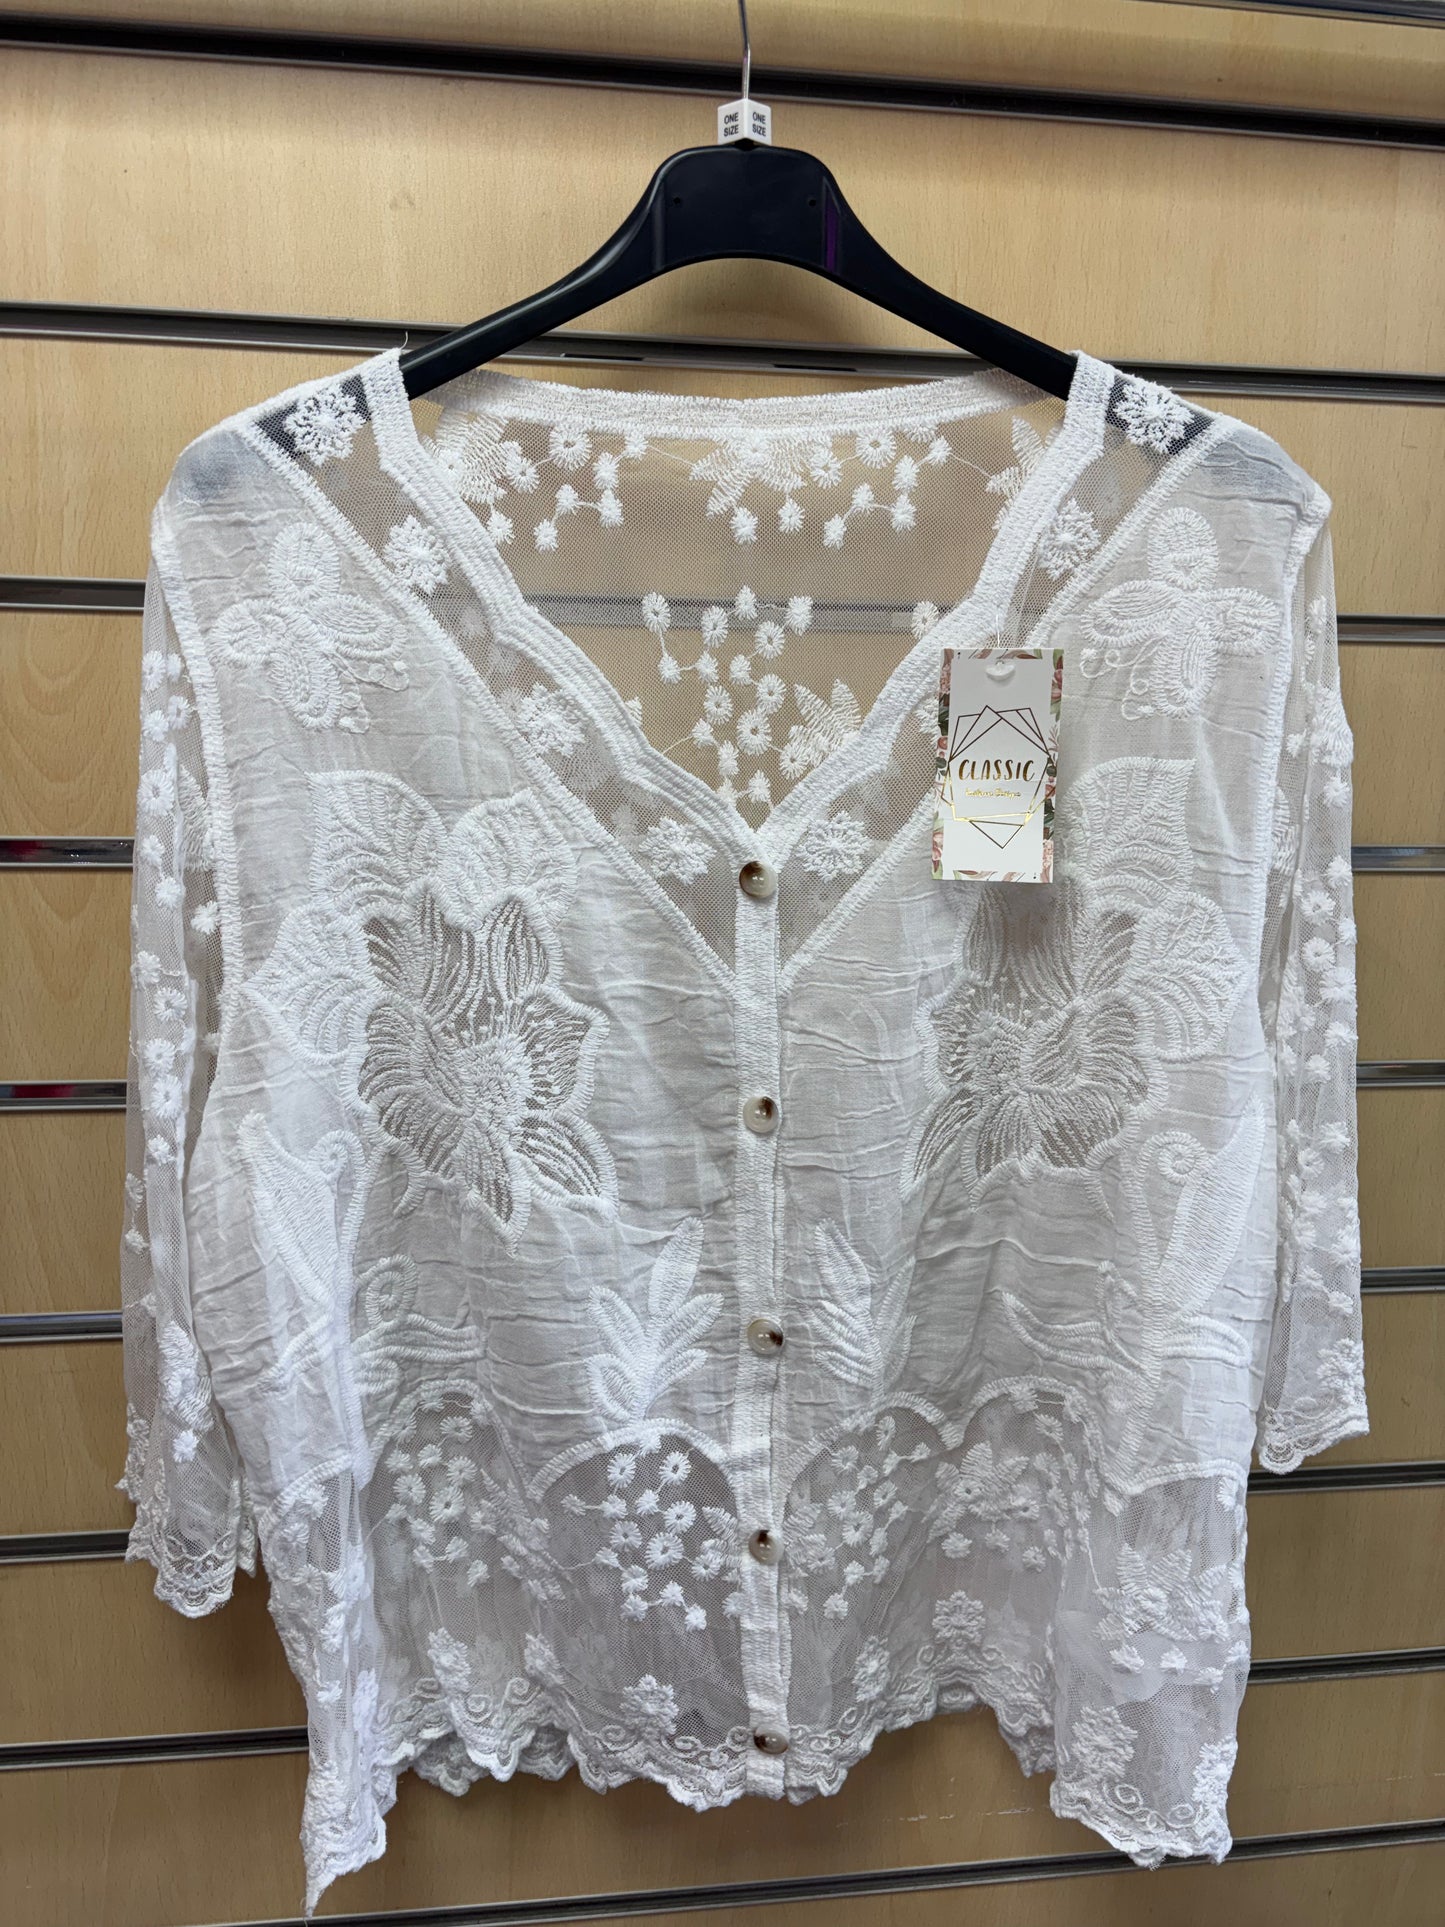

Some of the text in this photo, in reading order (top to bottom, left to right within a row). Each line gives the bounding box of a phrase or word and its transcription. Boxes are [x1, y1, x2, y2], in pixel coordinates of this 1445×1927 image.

[724, 112, 739, 125] ONE
[753, 112, 766, 124] ONE
[724, 124, 739, 137] SIZE
[752, 124, 766, 137] SIZE
[958, 759, 1035, 782] CLASSIC
